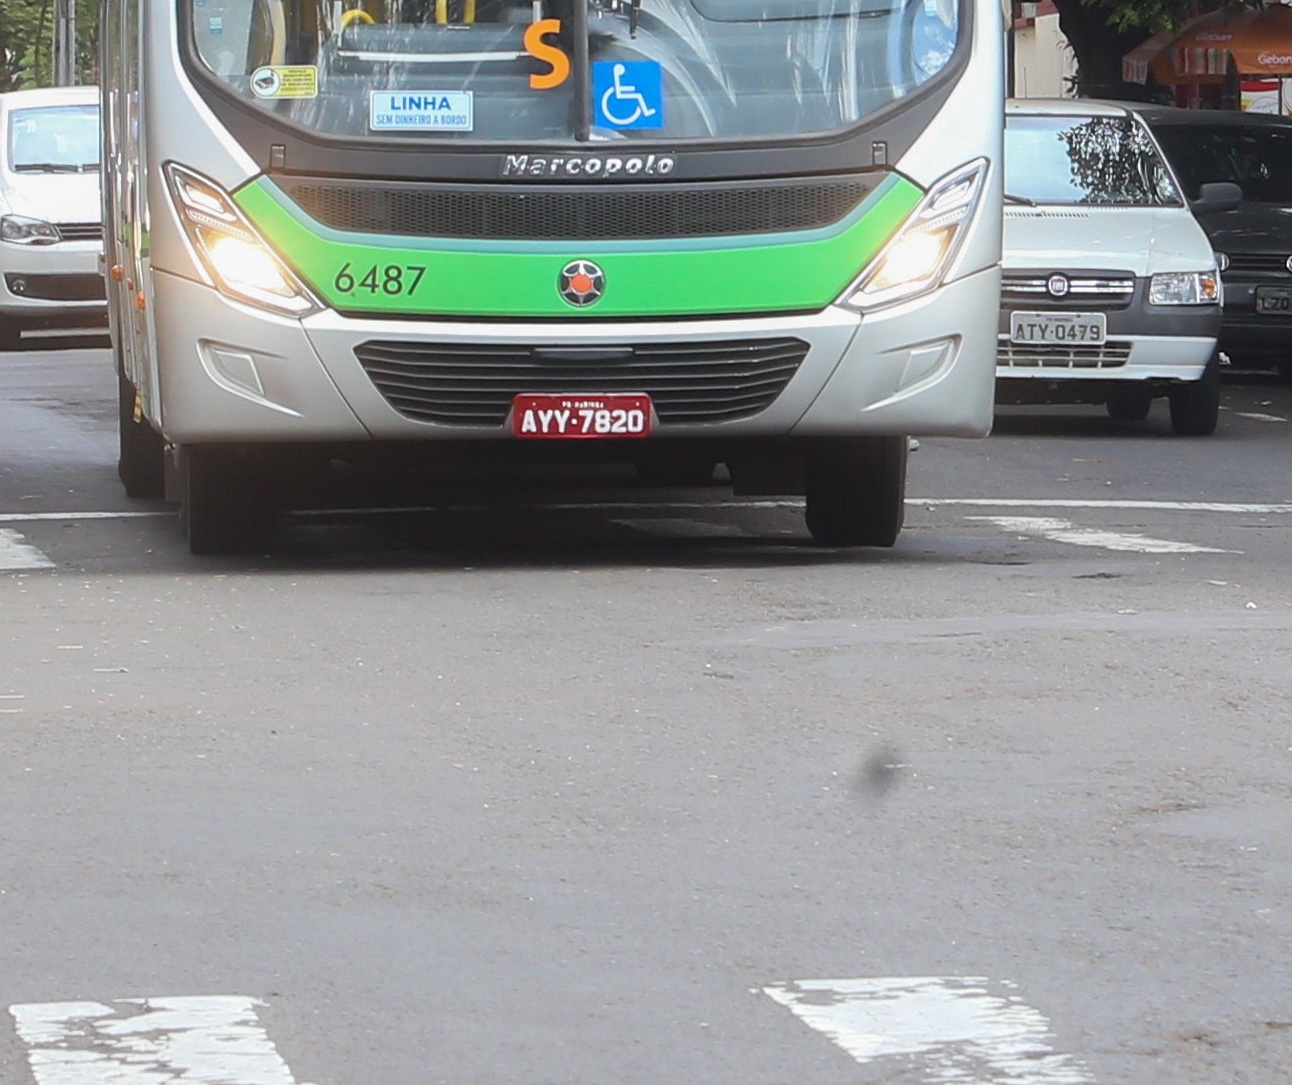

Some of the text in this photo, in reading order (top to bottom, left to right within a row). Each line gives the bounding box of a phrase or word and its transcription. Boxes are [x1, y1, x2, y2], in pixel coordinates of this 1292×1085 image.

[523, 18, 571, 89] S
[390, 96, 452, 111] LINHA
[376, 115, 467, 125] SEM DINHEIRO A BORDO
[503, 154, 674, 178] Marcopolo
[334, 262, 427, 296] 6487
